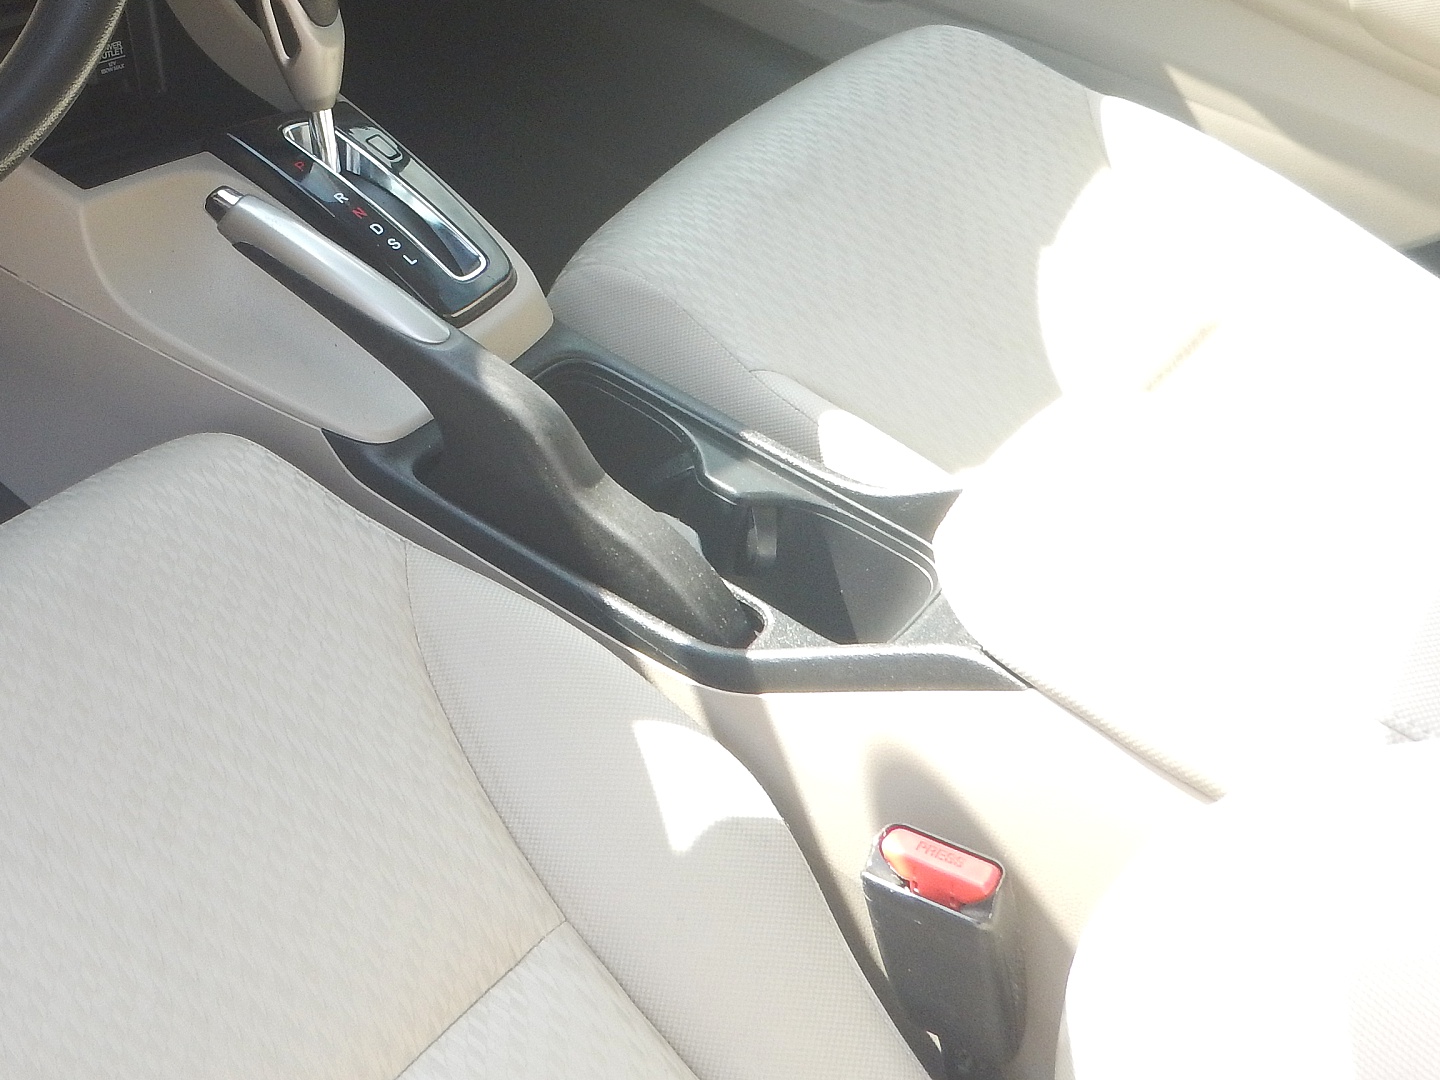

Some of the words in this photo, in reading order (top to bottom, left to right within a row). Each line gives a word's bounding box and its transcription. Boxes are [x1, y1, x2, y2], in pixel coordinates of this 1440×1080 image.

[101, 47, 124, 59] UTLET
[294, 161, 305, 172] P
[333, 192, 349, 204] R
[352, 206, 368, 219] N
[369, 223, 384, 235] D
[387, 238, 402, 250] S
[402, 254, 418, 266] L
[915, 840, 965, 868] PRESS
